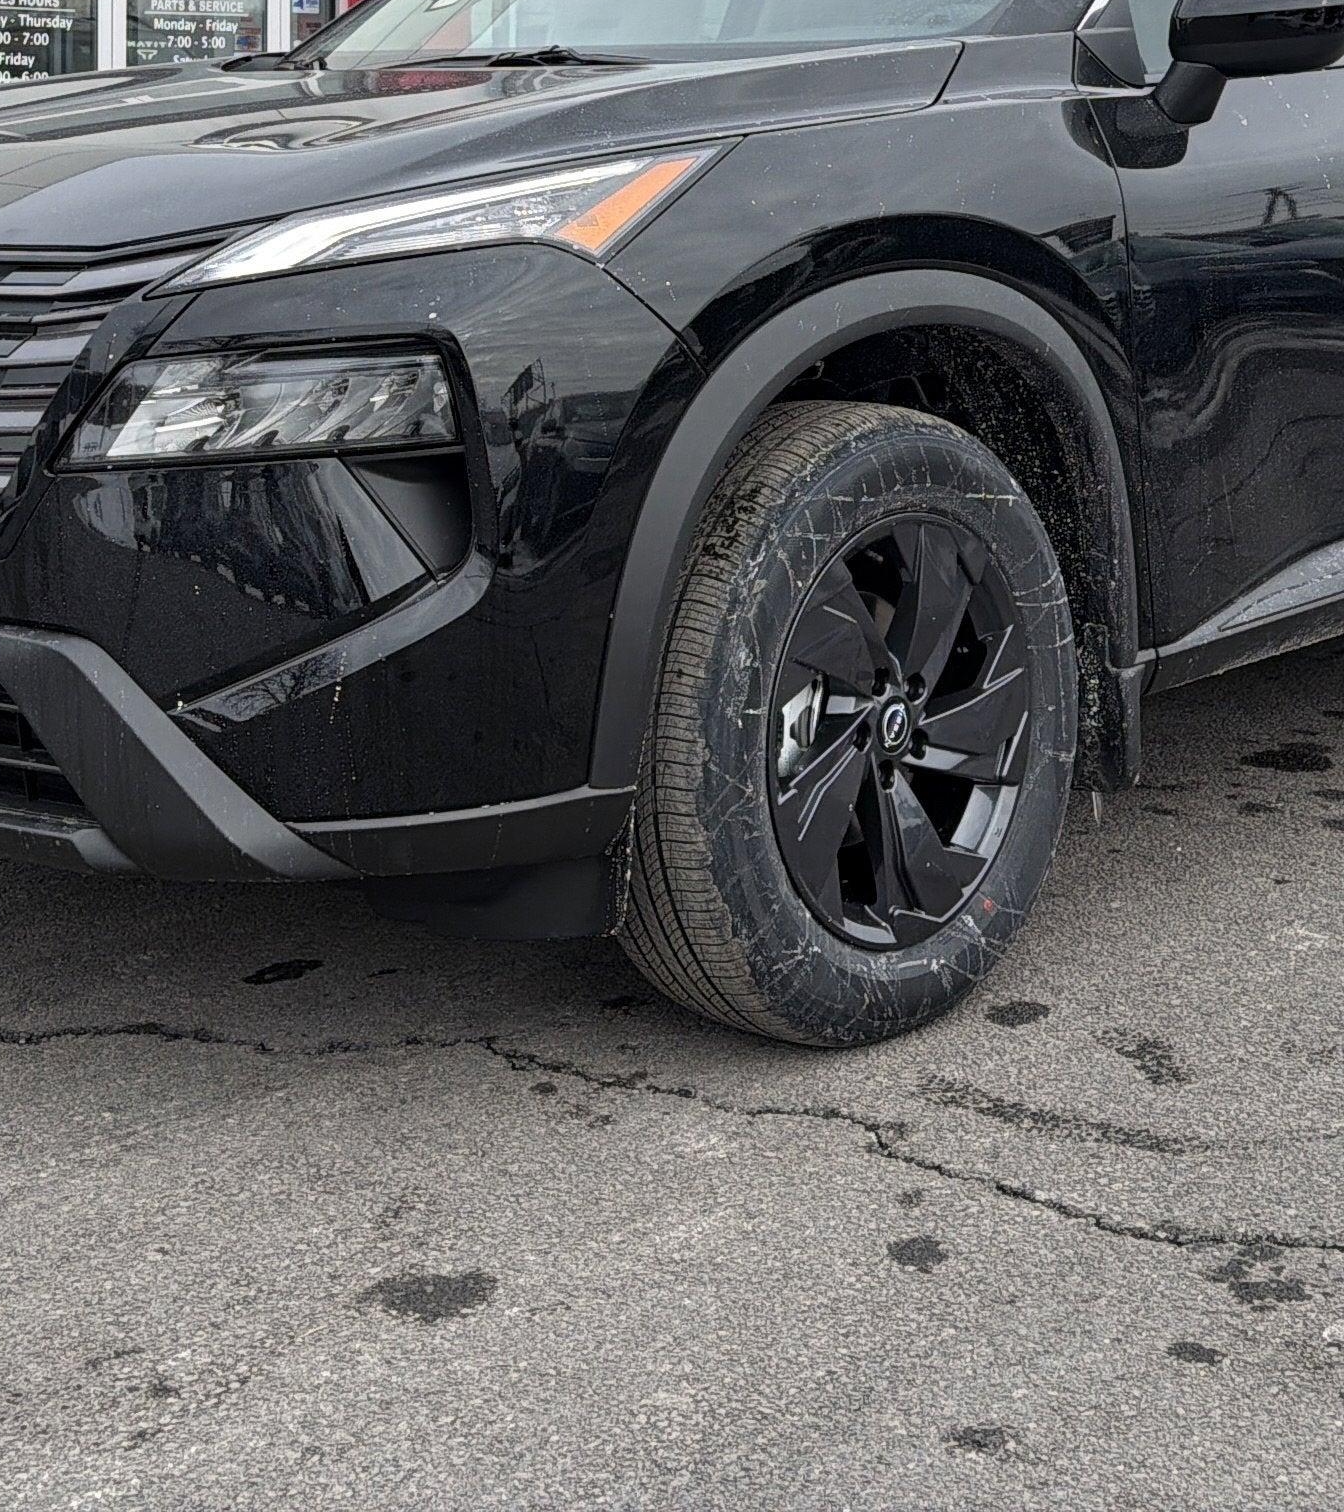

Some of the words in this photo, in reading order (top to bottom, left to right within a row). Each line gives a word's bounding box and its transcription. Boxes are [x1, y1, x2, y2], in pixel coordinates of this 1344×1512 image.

[187, 0, 196, 11] &
[199, 0, 244, 13] SERVICE
[18, 13, 73, 32] Thursday
[153, 18, 197, 33] Monday
[205, 18, 238, 35] Friday
[22, 32, 50, 46] 7:00
[167, 35, 192, 49] 7:00
[201, 36, 226, 49] 5:00
